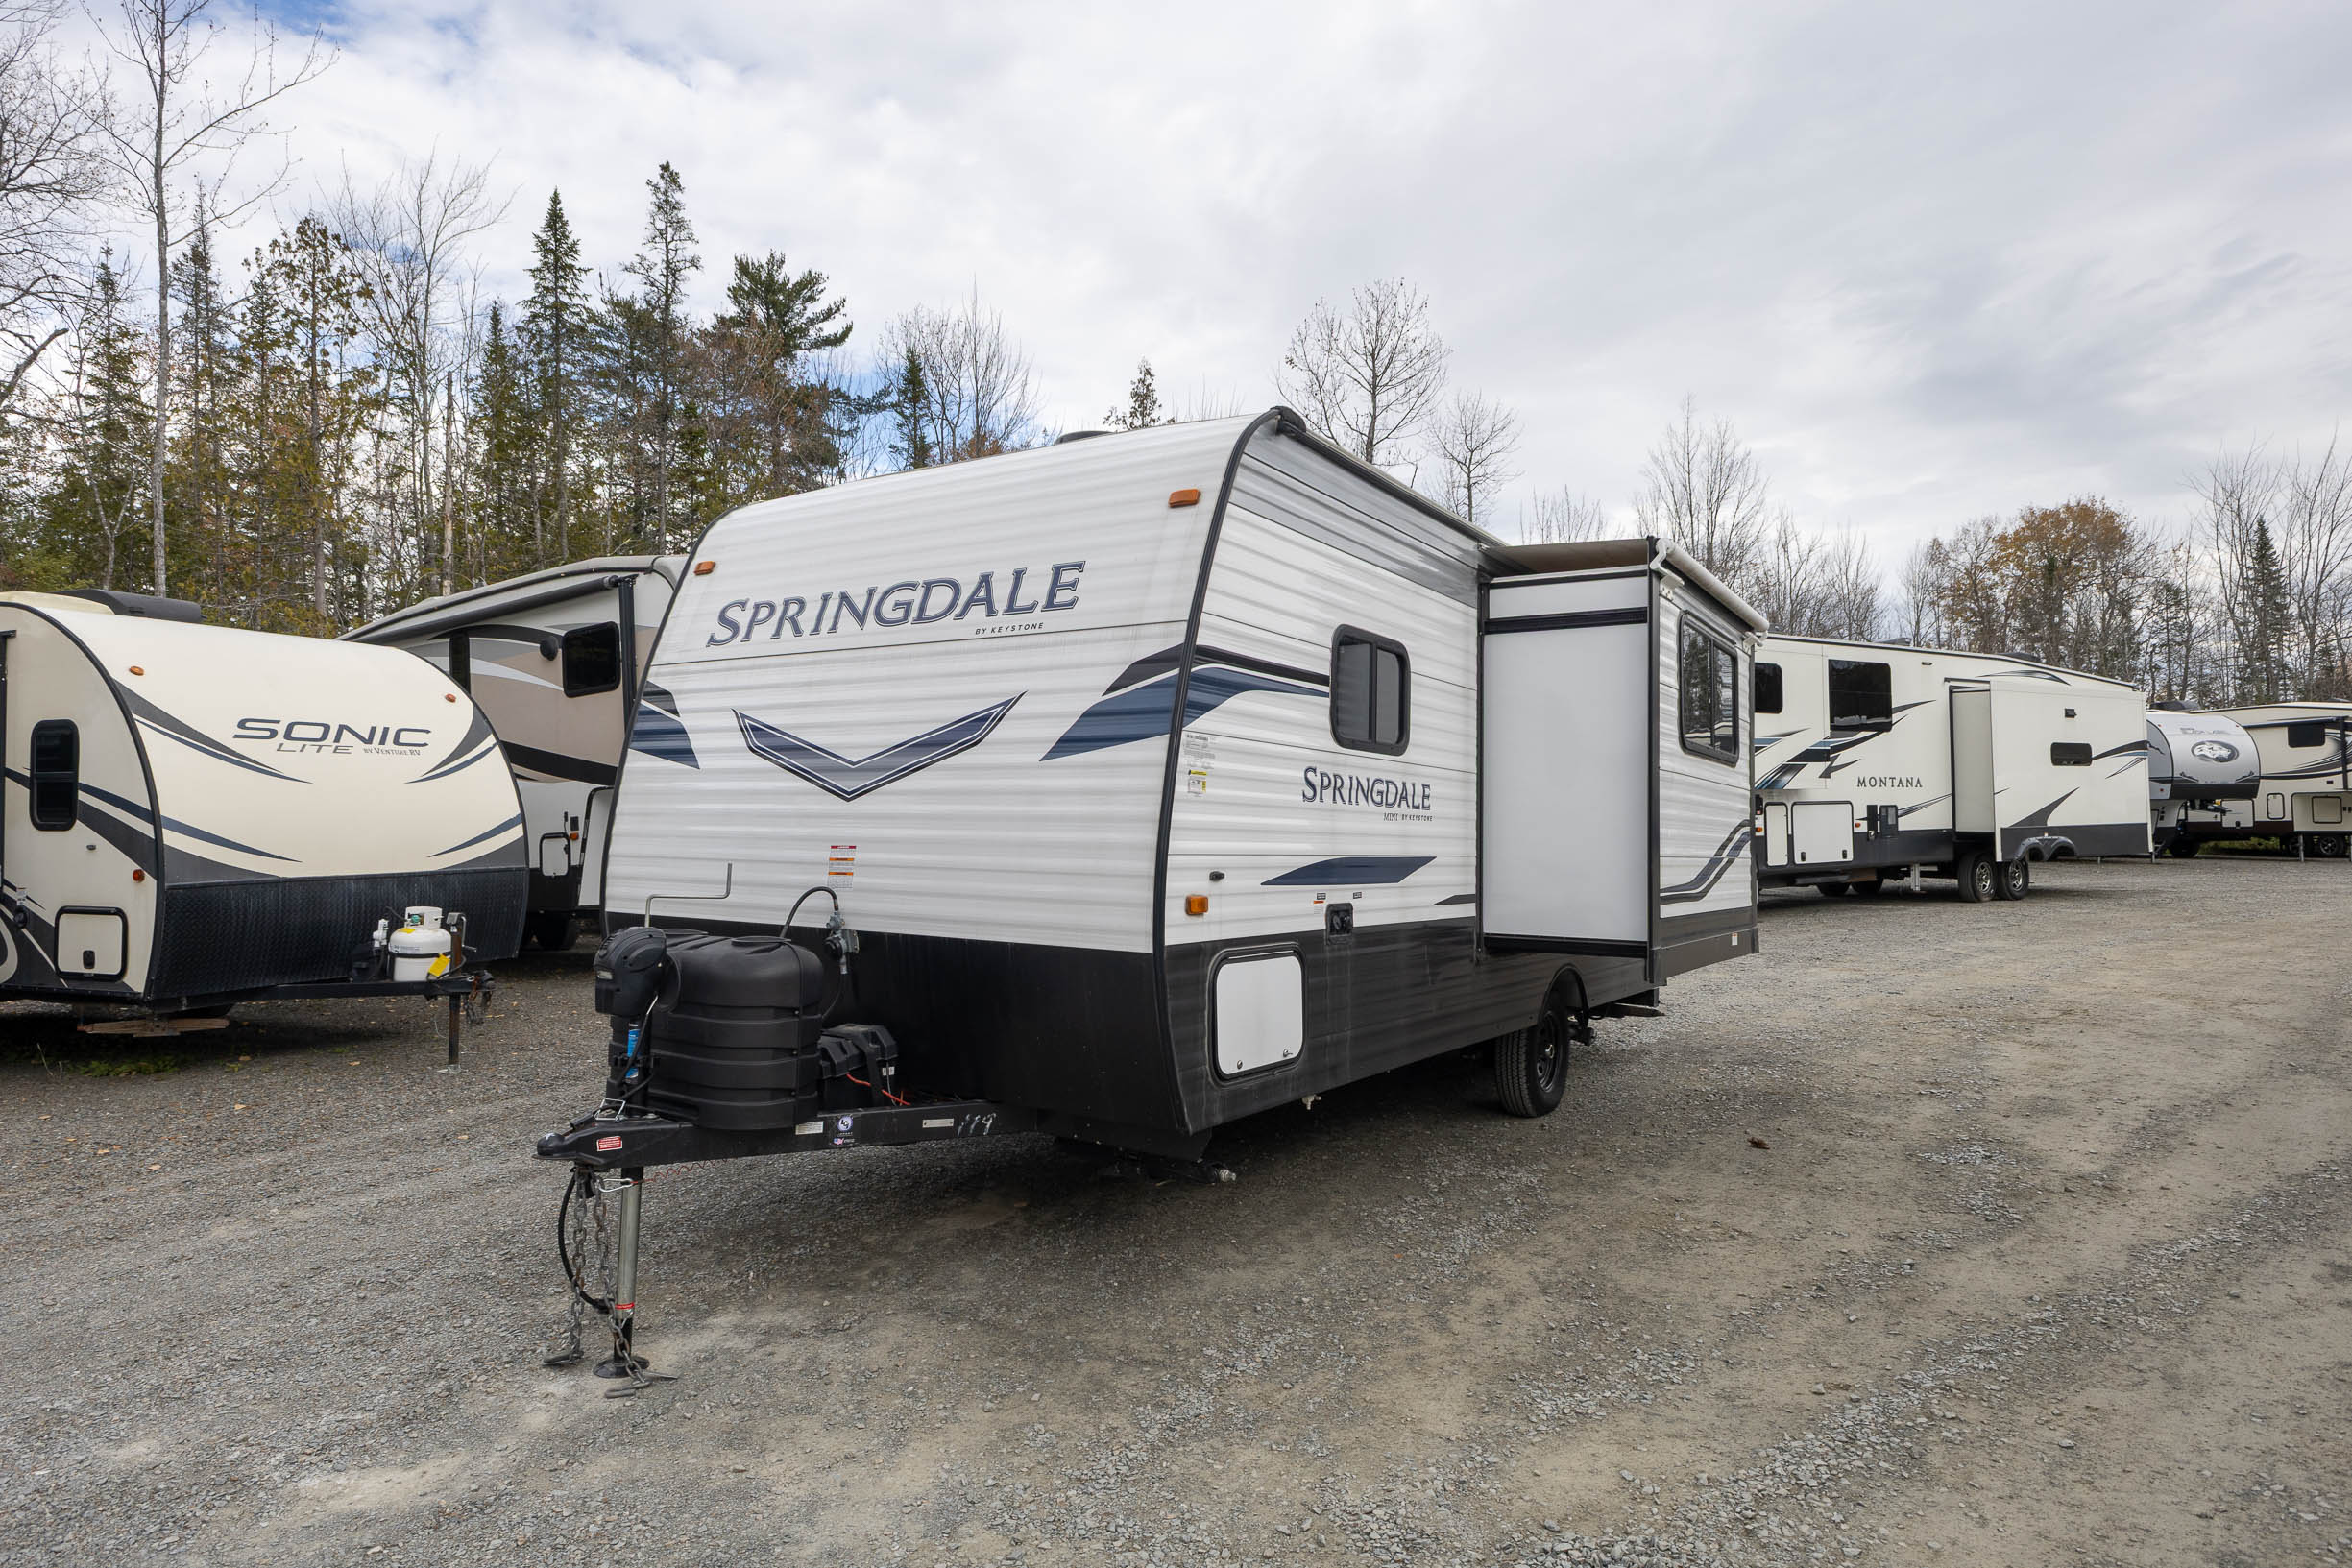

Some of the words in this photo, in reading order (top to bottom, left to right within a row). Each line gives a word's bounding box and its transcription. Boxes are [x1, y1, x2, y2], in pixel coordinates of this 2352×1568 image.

[706, 560, 1086, 648] SPRINGDALE
[991, 622, 1044, 634] KEYSTONE
[232, 718, 431, 747] SONIC
[277, 742, 354, 754] LITE
[1302, 766, 1431, 810] SPRINGDALE
[1856, 776, 1923, 788] MONTANA
[1384, 812, 1398, 821] MINI
